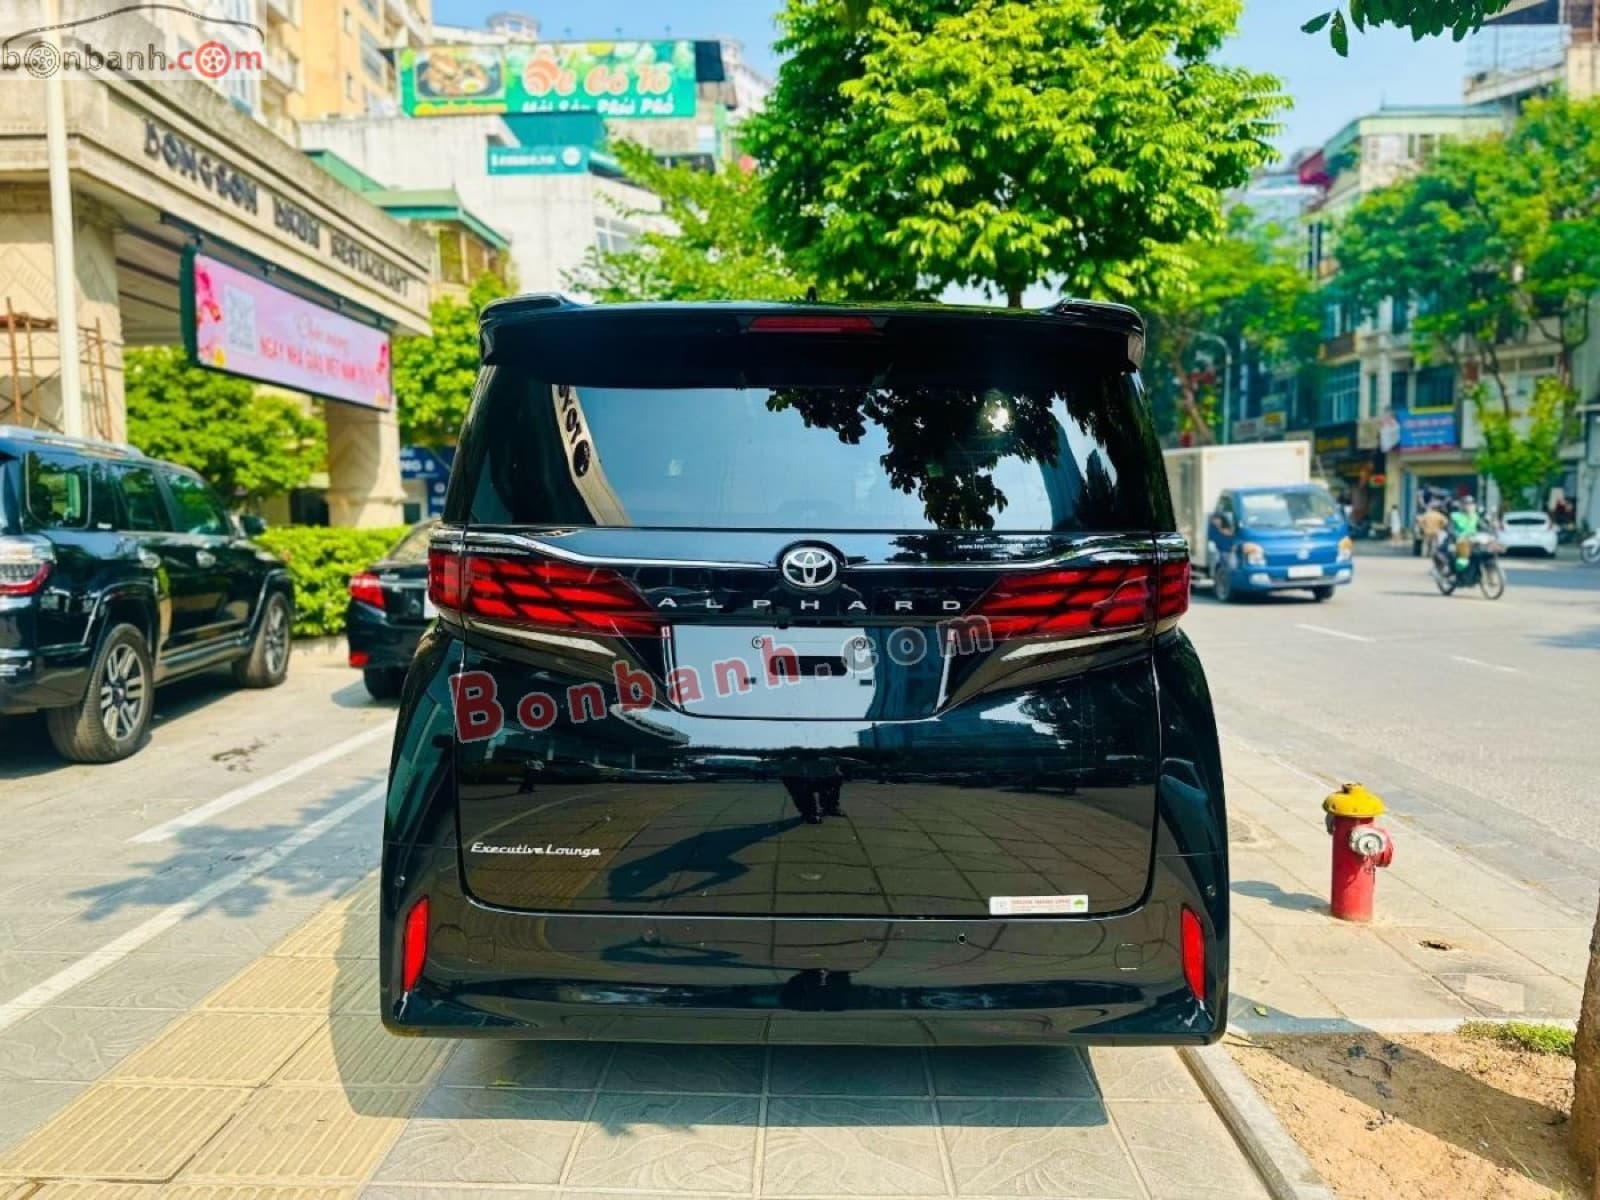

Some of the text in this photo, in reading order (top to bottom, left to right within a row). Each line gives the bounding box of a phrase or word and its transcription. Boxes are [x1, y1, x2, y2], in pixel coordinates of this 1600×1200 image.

[656, 597, 962, 611] ALPHARD
[470, 841, 601, 858] Executive Lounge
